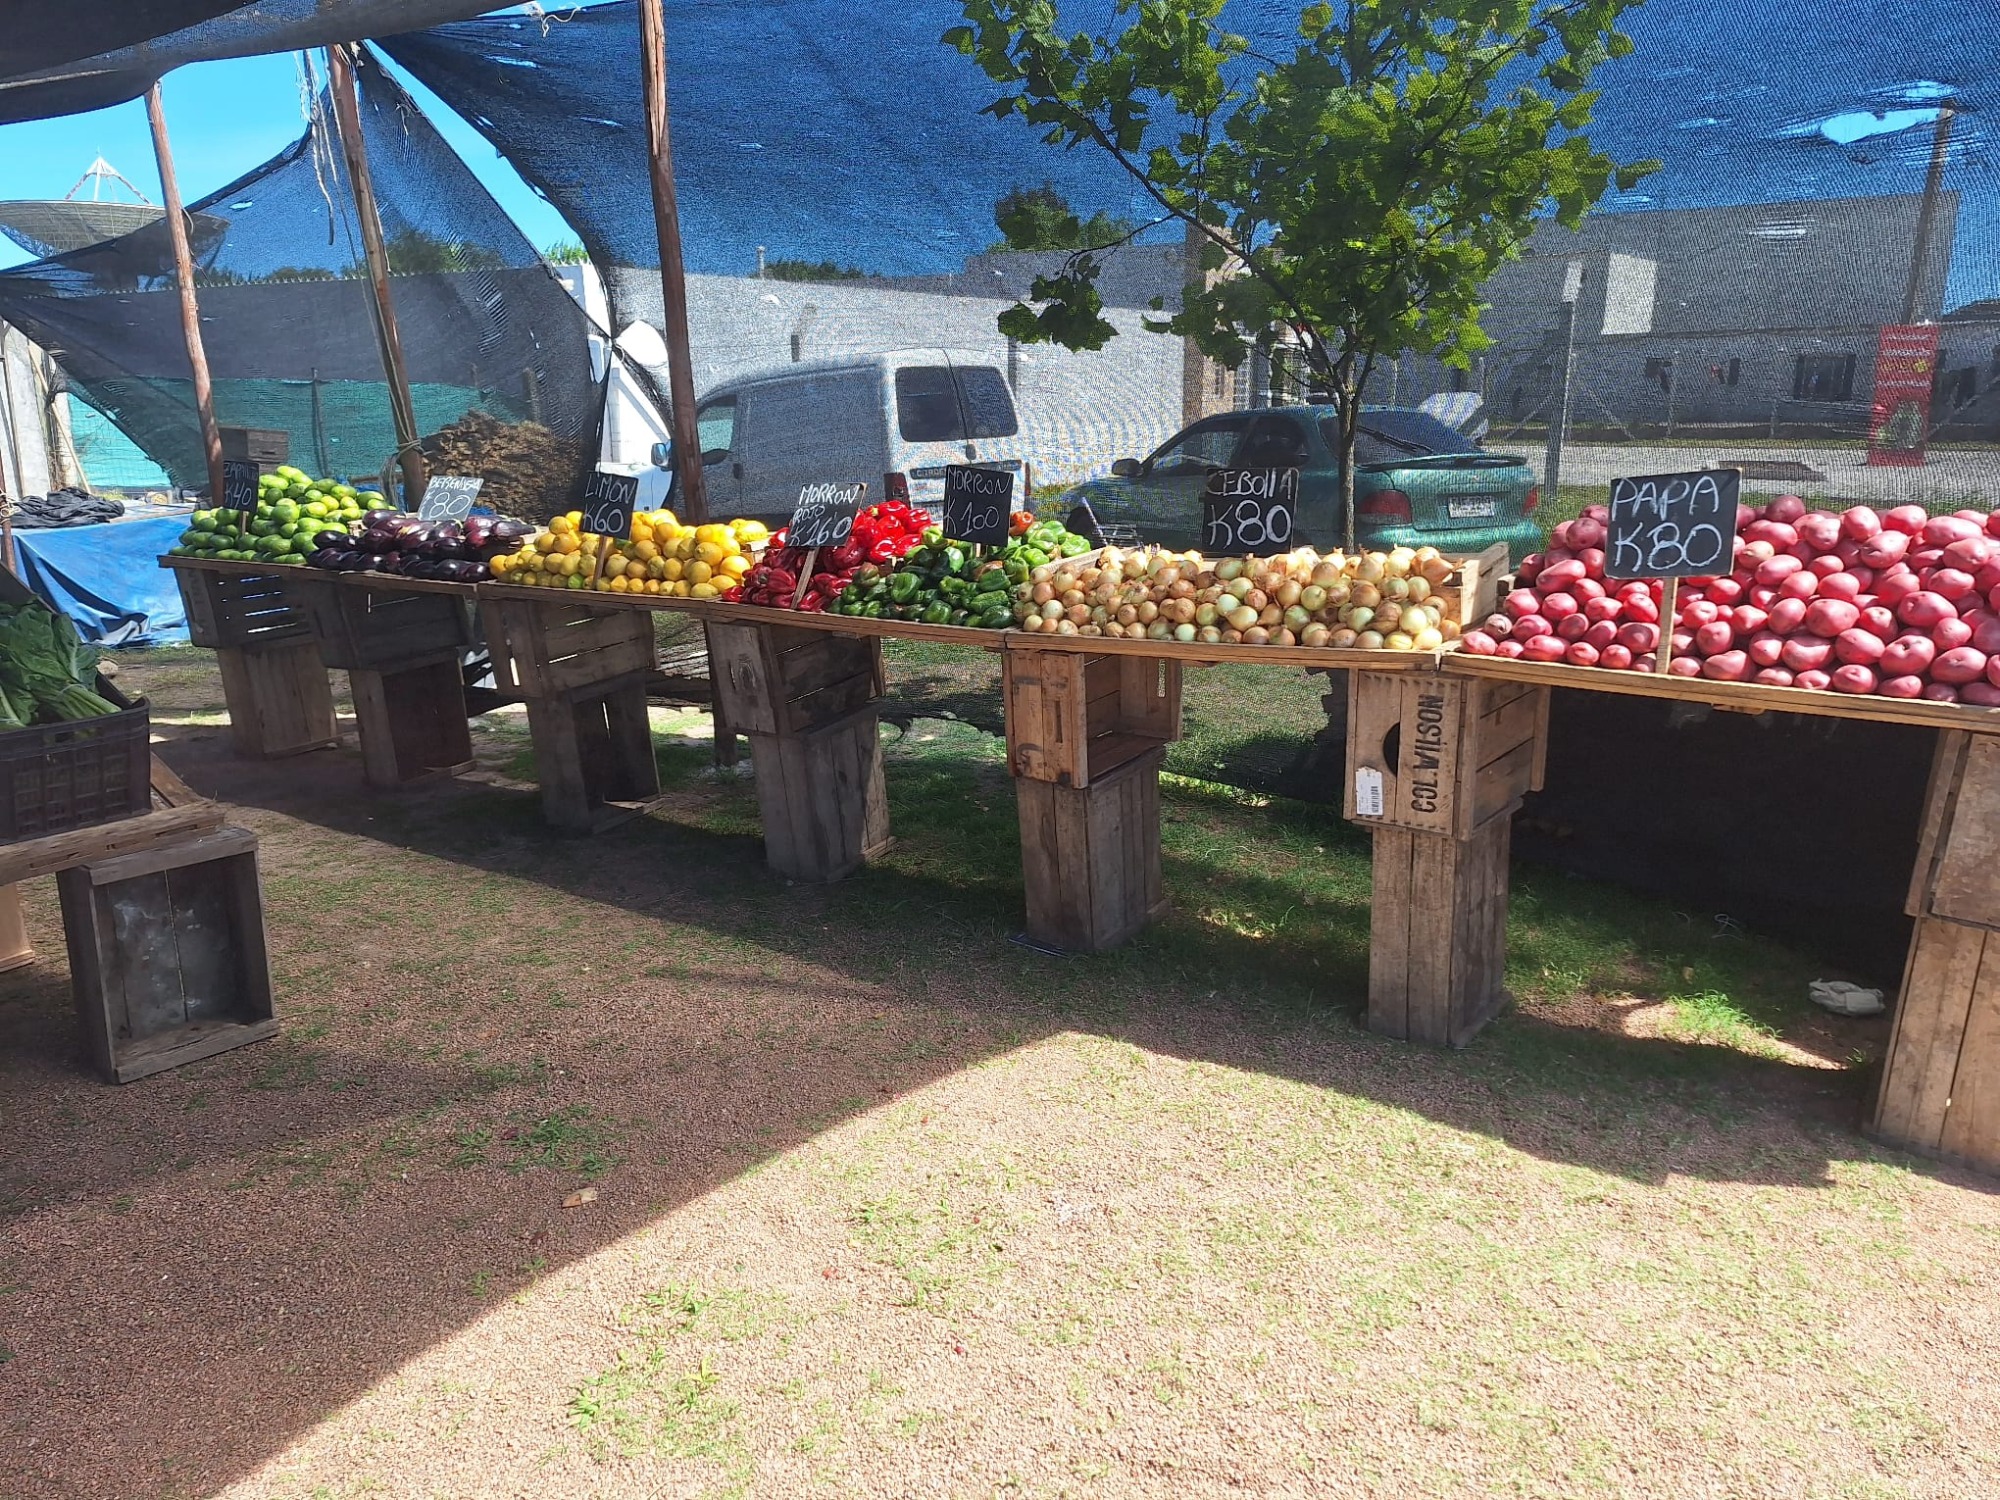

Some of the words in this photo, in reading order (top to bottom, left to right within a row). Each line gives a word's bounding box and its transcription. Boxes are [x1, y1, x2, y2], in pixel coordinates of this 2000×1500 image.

[798, 483, 860, 505] MORRON
[946, 466, 1012, 495] MORRON
[224, 482, 252, 510] K40
[1611, 475, 1720, 521] PAPA
[582, 503, 625, 533] K60
[792, 504, 825, 523] ROJO
[1207, 499, 1292, 549] K80
[1614, 522, 1723, 572] K80
